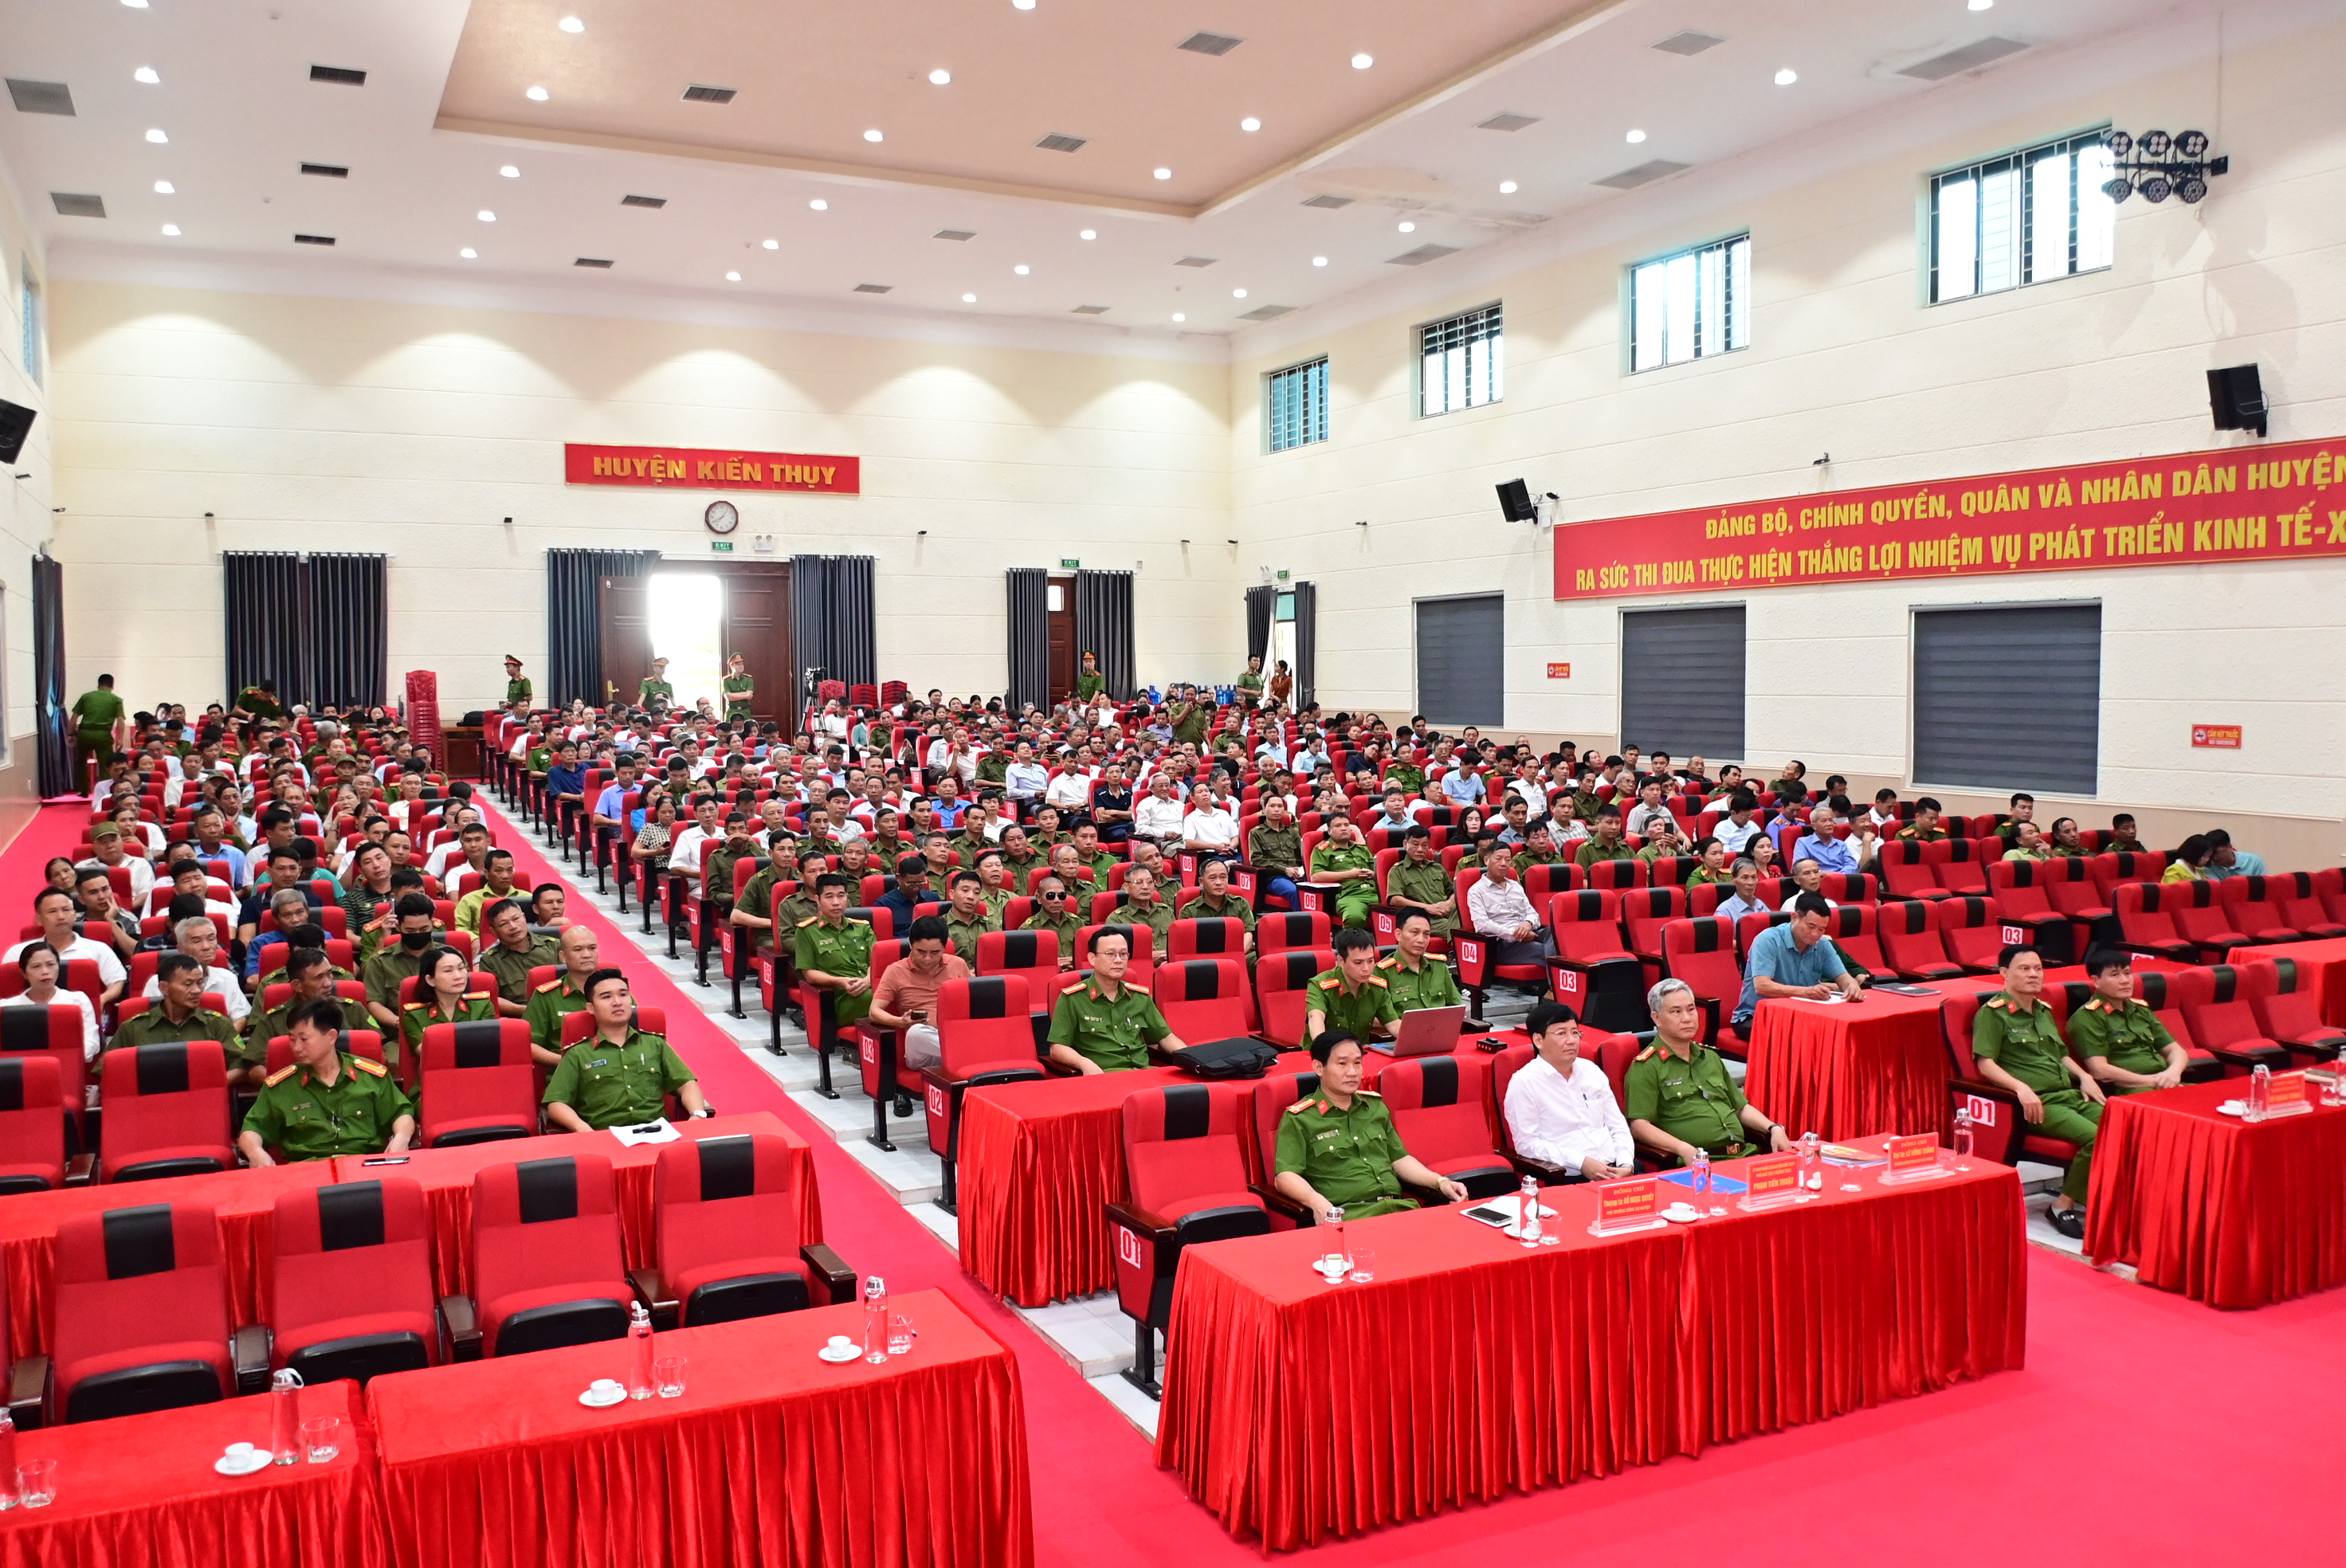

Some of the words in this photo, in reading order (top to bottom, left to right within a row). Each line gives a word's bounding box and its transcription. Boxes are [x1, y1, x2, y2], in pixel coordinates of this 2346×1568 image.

[594, 454, 687, 483] HUYỆN
[697, 457, 762, 482] KIẾN
[770, 464, 837, 488] THỤY
[1705, 510, 1756, 539] ĐẢNG
[1762, 508, 1793, 536] BỘ,
[1800, 502, 1864, 530] CHÍNH
[1871, 488, 1952, 525] QUYỀN,
[1961, 484, 2030, 517] QUÂN
[2038, 477, 2072, 508] VÀ
[2081, 470, 2162, 504] NHÂN
[2172, 463, 2237, 496] DÂN
[2247, 451, 2346, 491] HUYỆN
[1576, 569, 1595, 590] RA
[1599, 561, 1630, 589] SỨC
[1634, 563, 1658, 586] THI
[1662, 560, 1695, 585] ĐUA
[1700, 555, 1744, 586] THỰC
[1749, 548, 1792, 583] HIỆN
[1798, 539, 1862, 575] THẮNG
[1869, 541, 1901, 576] LỢI
[1909, 533, 1983, 572] NHIỆM
[1991, 534, 2022, 569] VỤ
[2030, 523, 2095, 561] PHÁT
[2103, 511, 2184, 556] TRIỂN
[2194, 515, 2266, 551] KINH
[1183, 857, 1191, 870] 08
[1241, 875, 1250, 888] 07
[1305, 894, 1315, 908] 06
[1379, 914, 1391, 931] 05
[2005, 928, 2020, 943] 03
[1463, 944, 1476, 961] 04
[1562, 972, 1575, 990] 03
[865, 1040, 873, 1060] 03
[931, 1088, 941, 1112] 02
[1971, 1099, 1992, 1123] 01
[1123, 1230, 1139, 1264] 01
